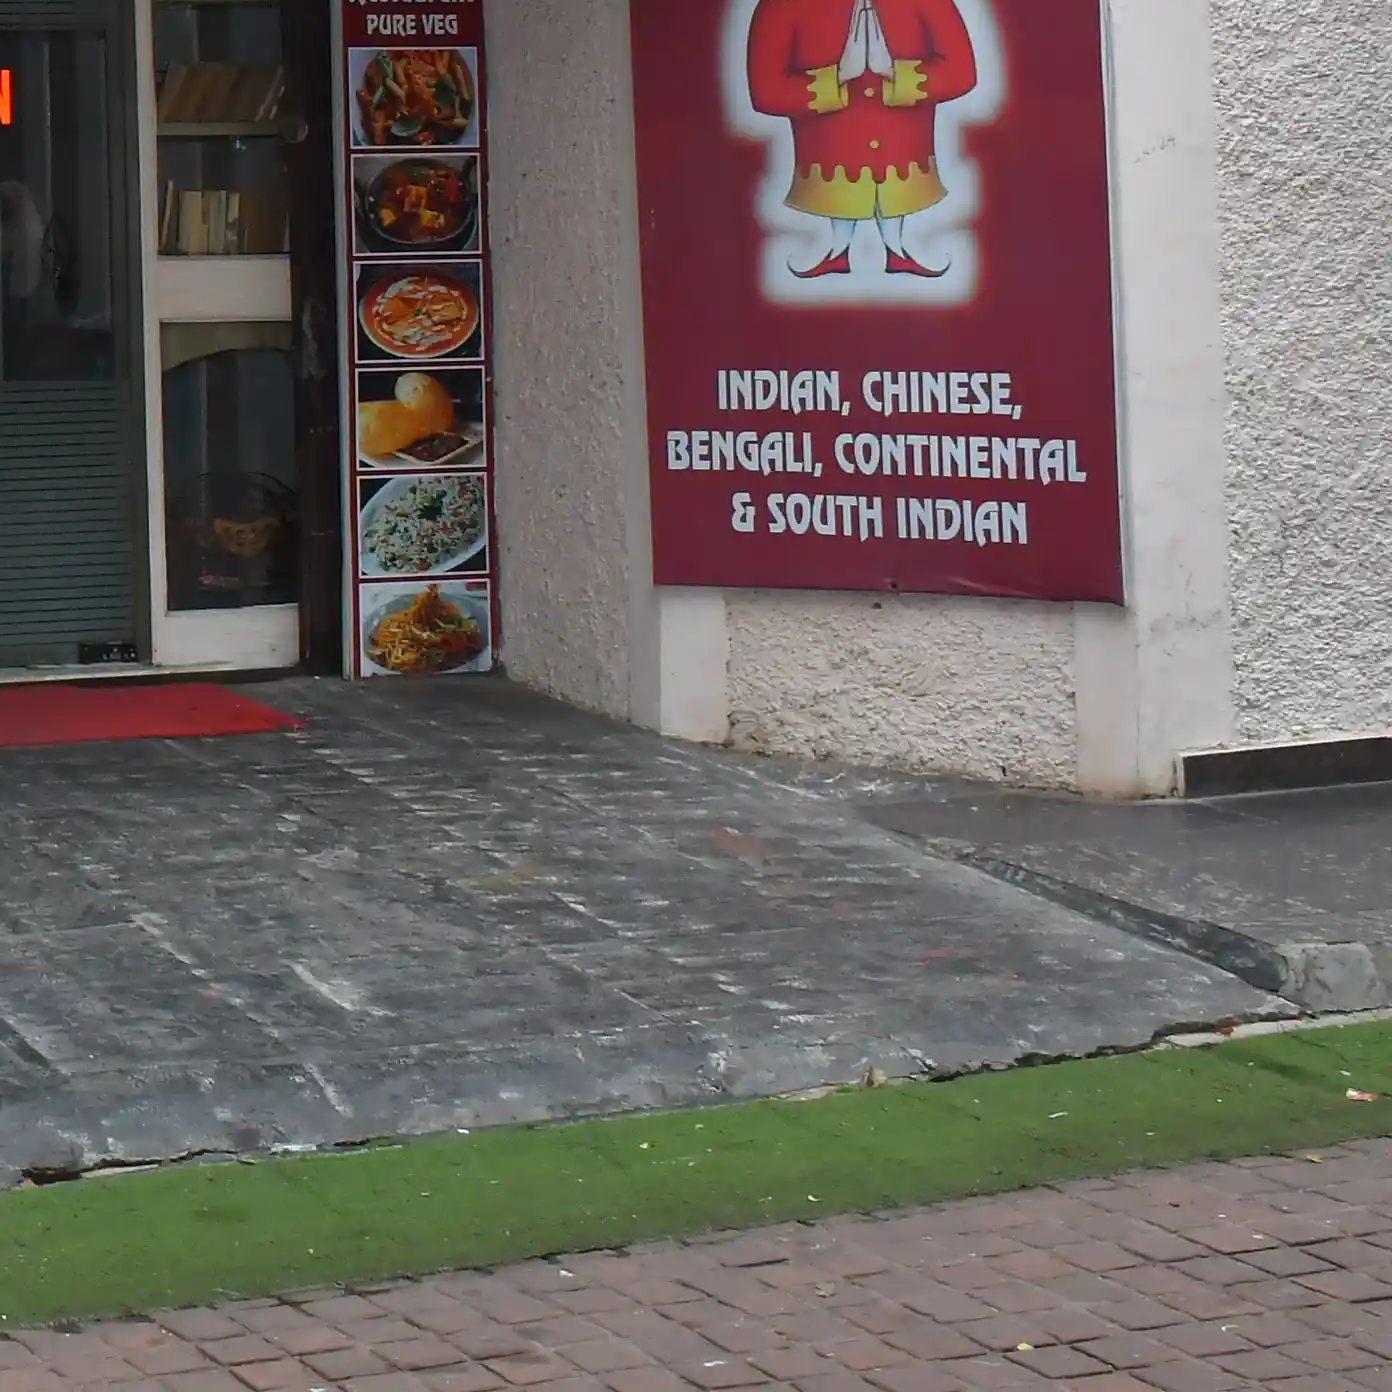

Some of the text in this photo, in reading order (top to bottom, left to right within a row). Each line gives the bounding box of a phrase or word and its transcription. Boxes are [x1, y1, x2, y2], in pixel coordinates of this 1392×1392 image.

[366, 13, 458, 36] PURE VEG
[718, 370, 1023, 420] INDIAN, CHINESE,
[666, 430, 1087, 486] BENGALI, CONTINENTAL
[731, 492, 1028, 547] & SOUTH INDIAN
